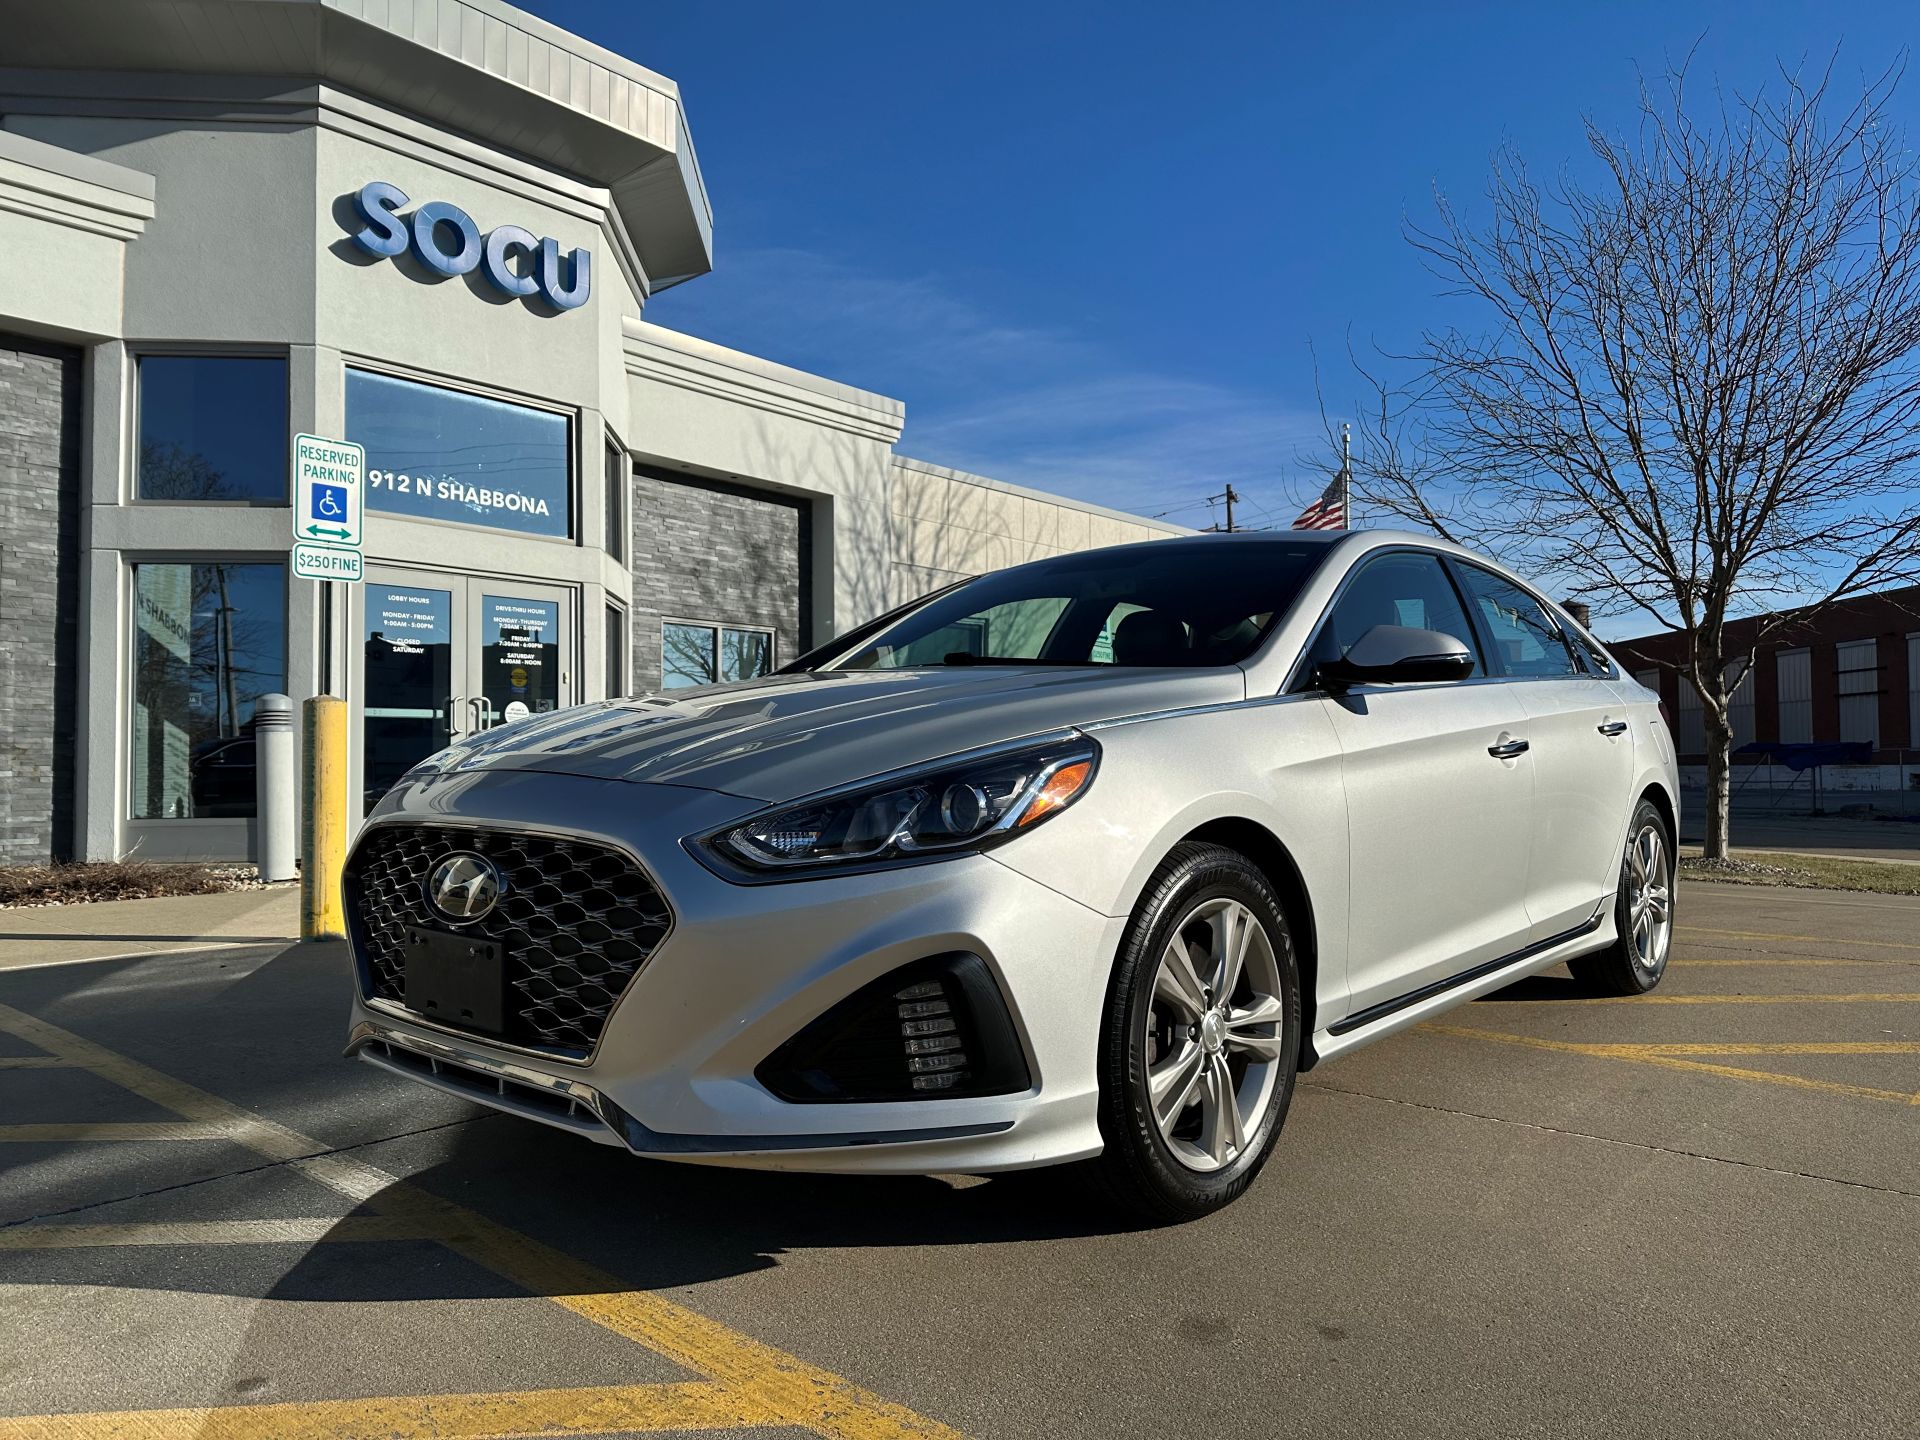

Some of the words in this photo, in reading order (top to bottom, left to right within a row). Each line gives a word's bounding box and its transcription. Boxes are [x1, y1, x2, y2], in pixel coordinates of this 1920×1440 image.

[352, 181, 591, 311] SOCU
[300, 445, 359, 467] RESERVED
[304, 464, 355, 484] PARKING
[369, 470, 410, 493] 912
[416, 477, 432, 497] N
[437, 481, 549, 516] SHABBONA
[299, 552, 330, 569] $250
[331, 557, 359, 572] FINE
[382, 611, 411, 619] MONDAY
[496, 605, 527, 613] DRIVE-THRU
[392, 646, 424, 654] SATURDAY
